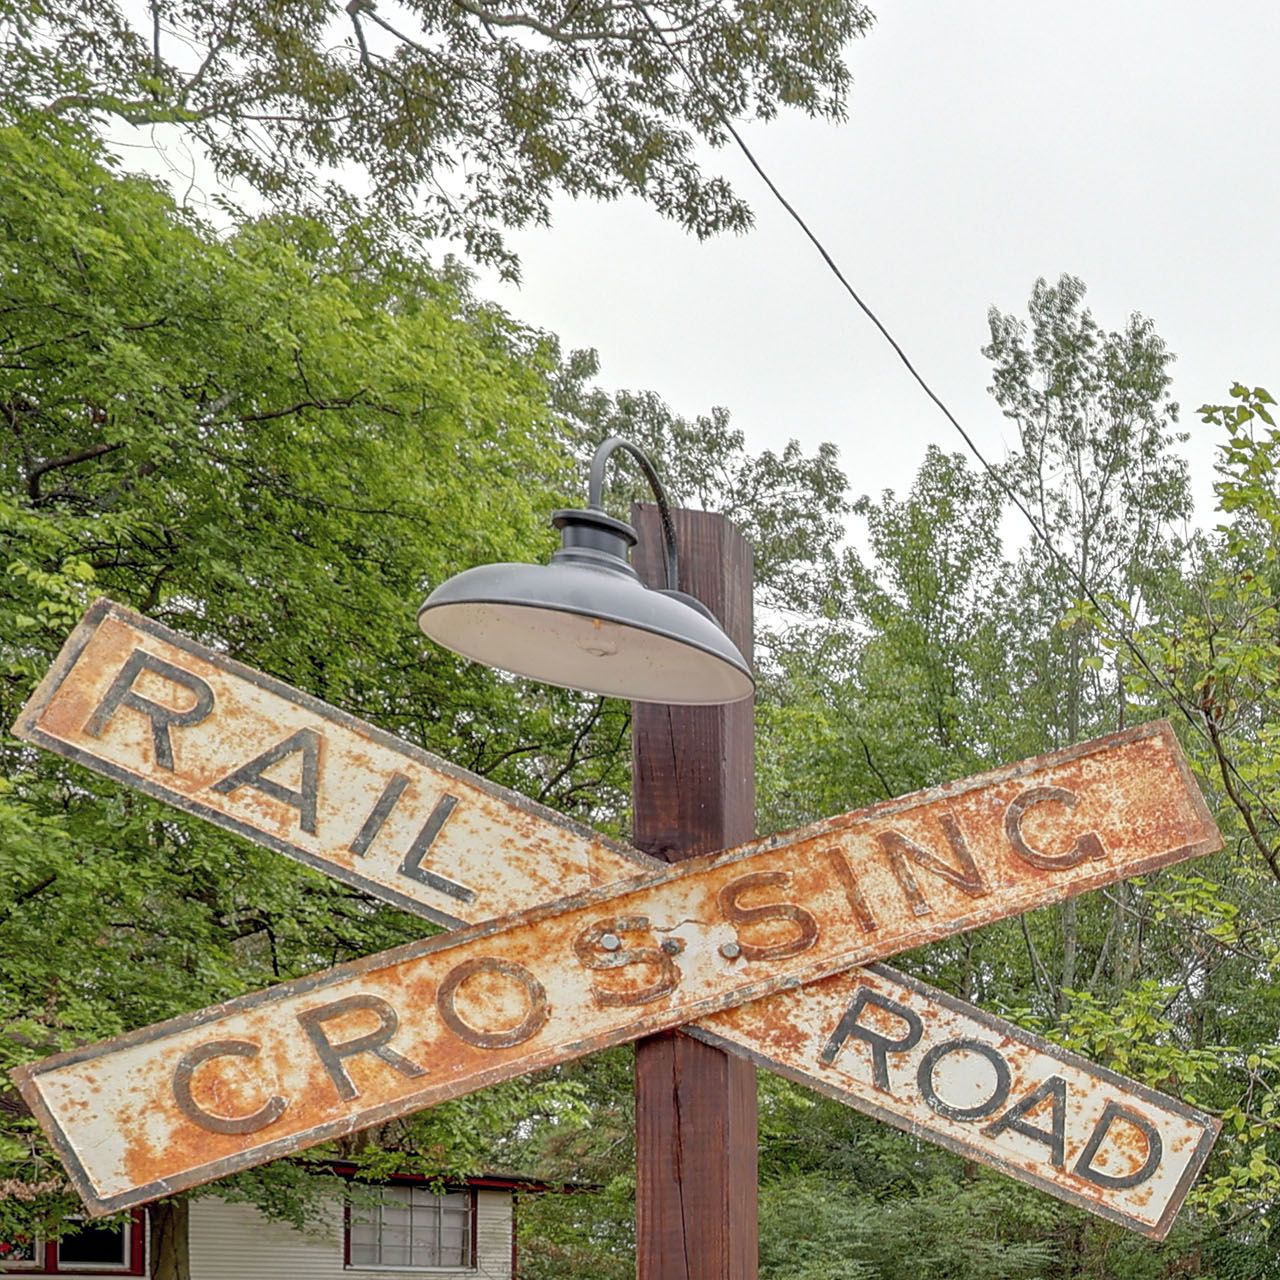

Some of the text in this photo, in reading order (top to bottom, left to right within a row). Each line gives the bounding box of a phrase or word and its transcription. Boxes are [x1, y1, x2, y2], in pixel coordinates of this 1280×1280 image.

[85, 647, 1164, 1190] RAIL ROAD
[172, 786, 1109, 1136] CROSSING
